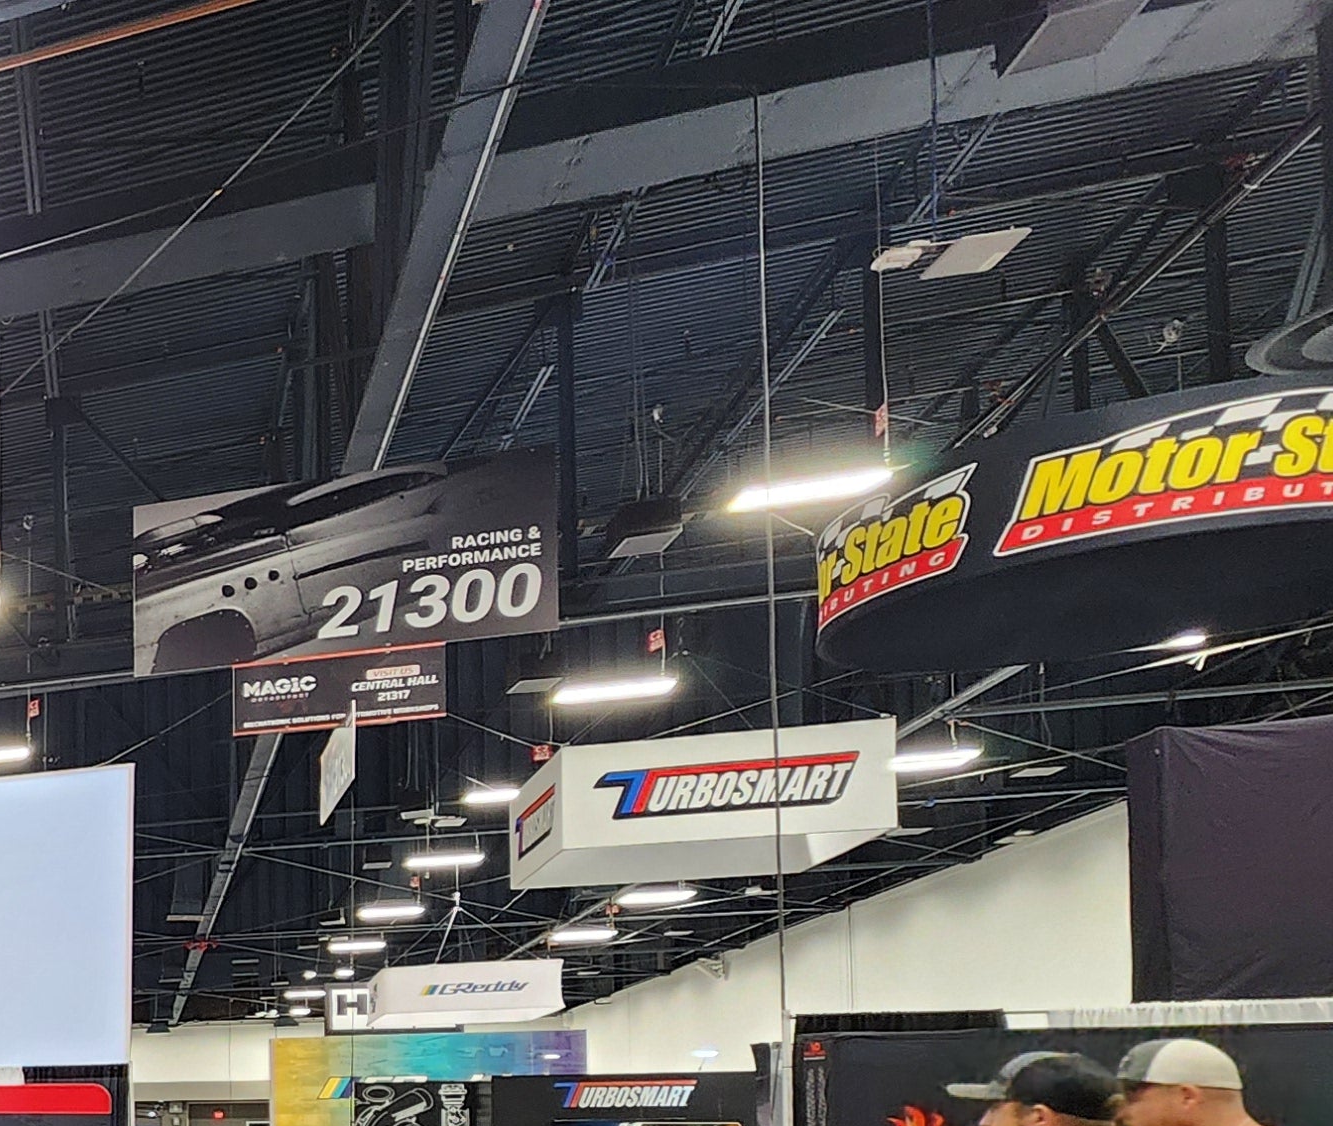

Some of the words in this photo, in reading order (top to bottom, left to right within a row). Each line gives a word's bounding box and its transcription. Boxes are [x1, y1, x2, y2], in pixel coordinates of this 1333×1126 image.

[1020, 429, 1262, 521] Motor
[452, 528, 522, 550] RACING
[527, 526, 541, 540] &
[841, 496, 963, 585] State
[402, 543, 542, 573] PERFORMANCE
[318, 562, 542, 639] 21300
[351, 679, 405, 692] CENTRAL
[407, 675, 438, 688] HALL
[377, 690, 411, 701] 21317
[595, 751, 859, 819] TURBOSMART
[554, 1079, 698, 1108] TURBOSMART
